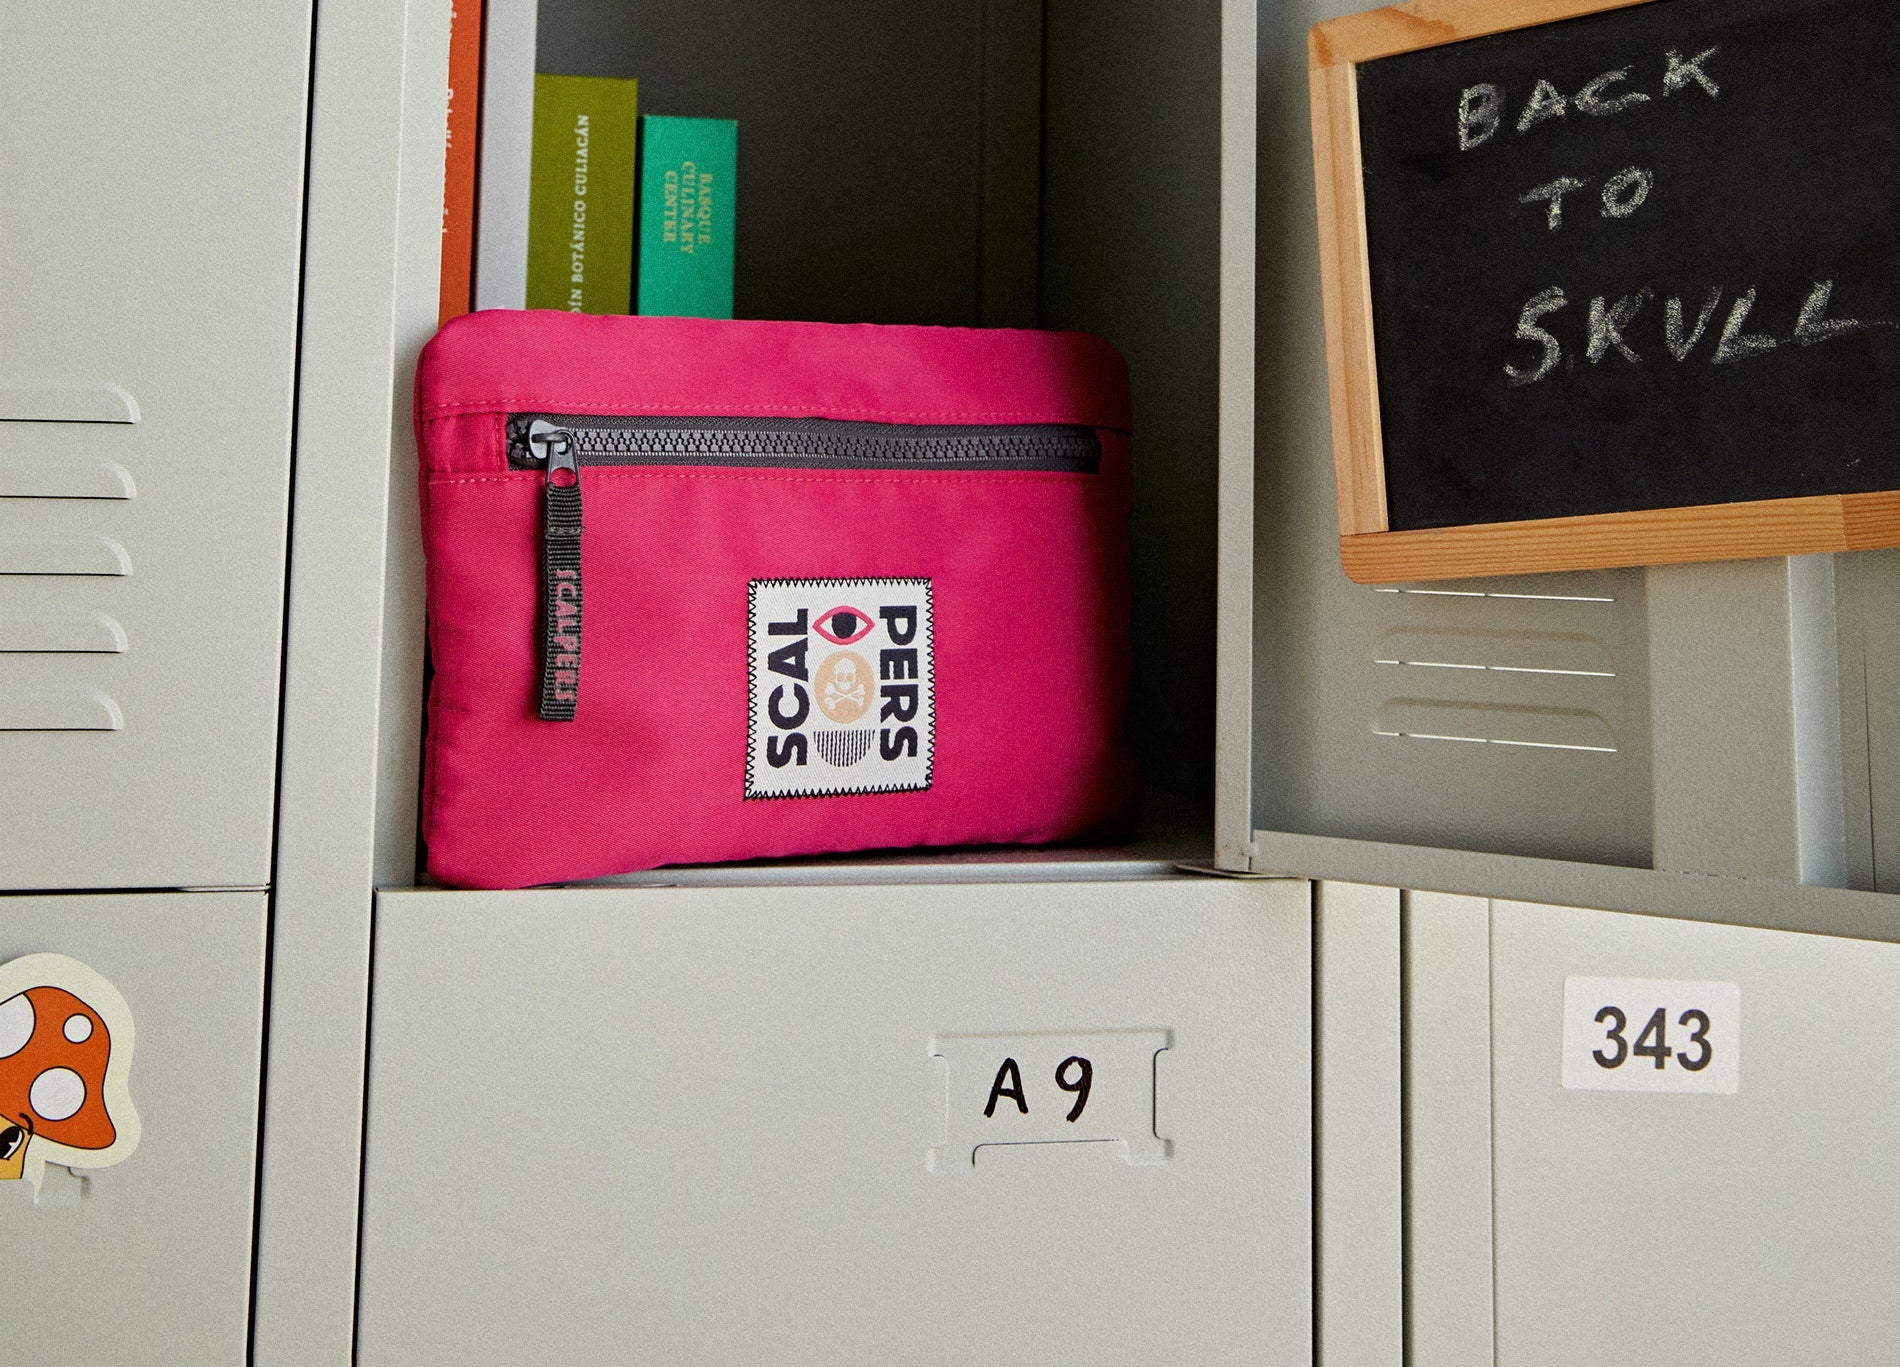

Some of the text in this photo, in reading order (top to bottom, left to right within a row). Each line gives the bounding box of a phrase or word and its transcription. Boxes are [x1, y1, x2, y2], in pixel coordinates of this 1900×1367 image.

[1458, 46, 1720, 152] BACK
[575, 114, 590, 196] CULIACÁN
[663, 170, 679, 243] CENTER
[680, 161, 696, 255] CULINARY
[697, 173, 713, 245] BASQUE
[1518, 165, 1654, 231] TO
[570, 199, 587, 284] BOTÁNICO
[554, 568, 578, 702] SCALPERS
[766, 608, 810, 769] SCAL
[879, 605, 919, 762] PERS
[1592, 1005, 1713, 1072] 343
[983, 1055, 1093, 1122] A 9
